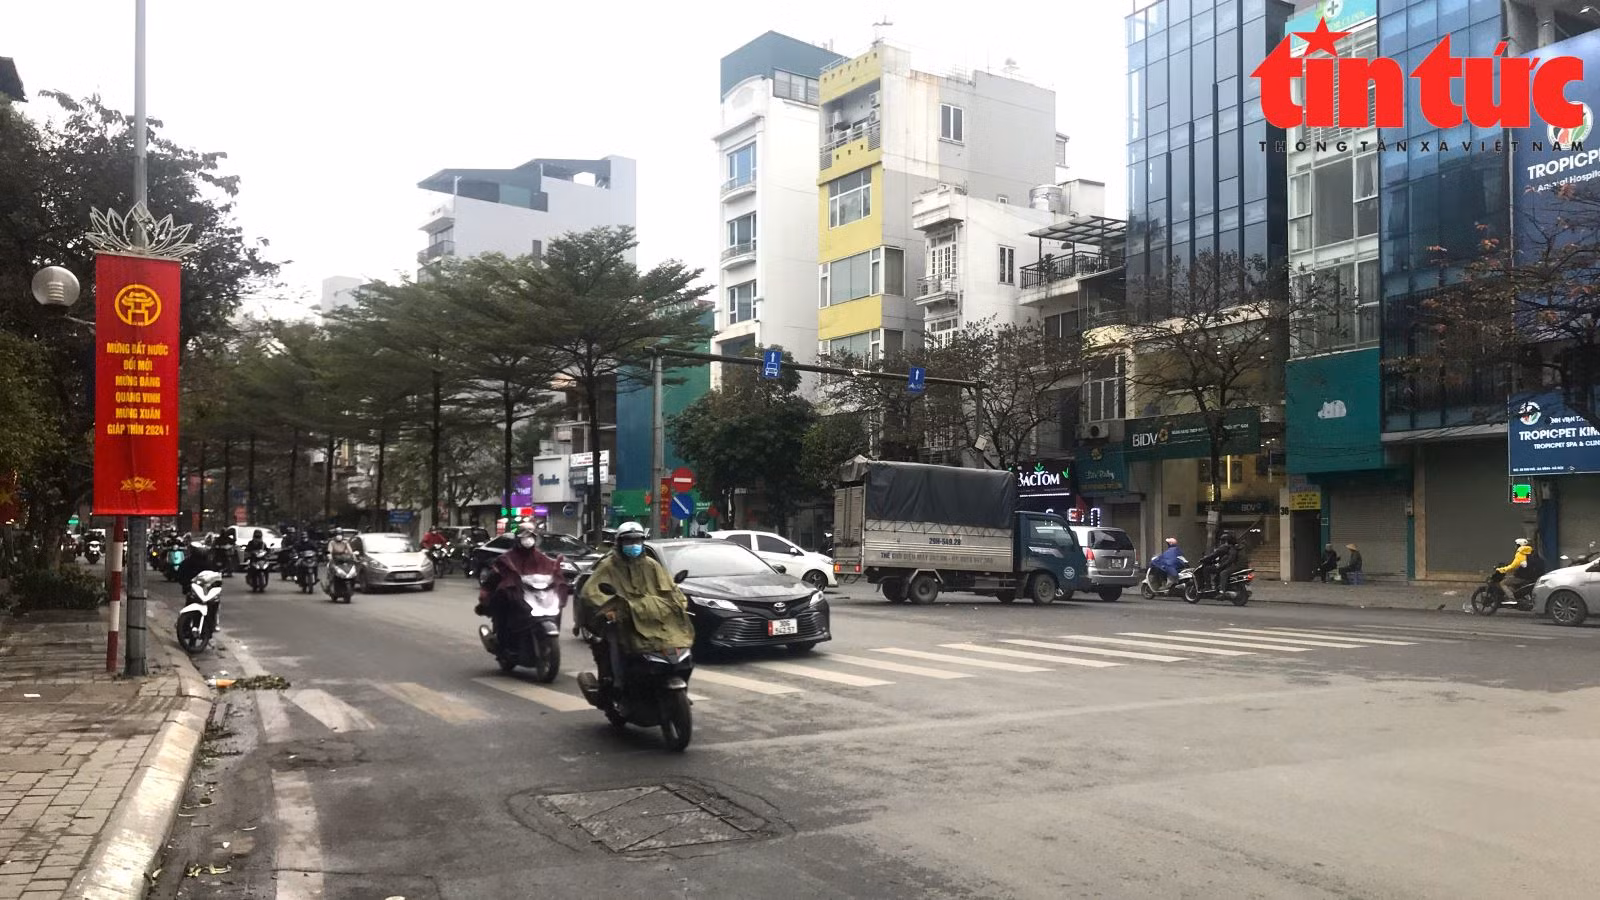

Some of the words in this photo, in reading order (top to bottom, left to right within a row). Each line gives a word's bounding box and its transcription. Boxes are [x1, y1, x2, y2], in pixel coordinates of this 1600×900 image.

[1527, 148, 1600, 179] TROPICP
[115, 391, 141, 404] QUANG
[142, 392, 161, 404] VINH
[145, 424, 164, 436] 2024
[1518, 427, 1577, 441] TROPICPET
[1533, 442, 1565, 450] TROPICPET
